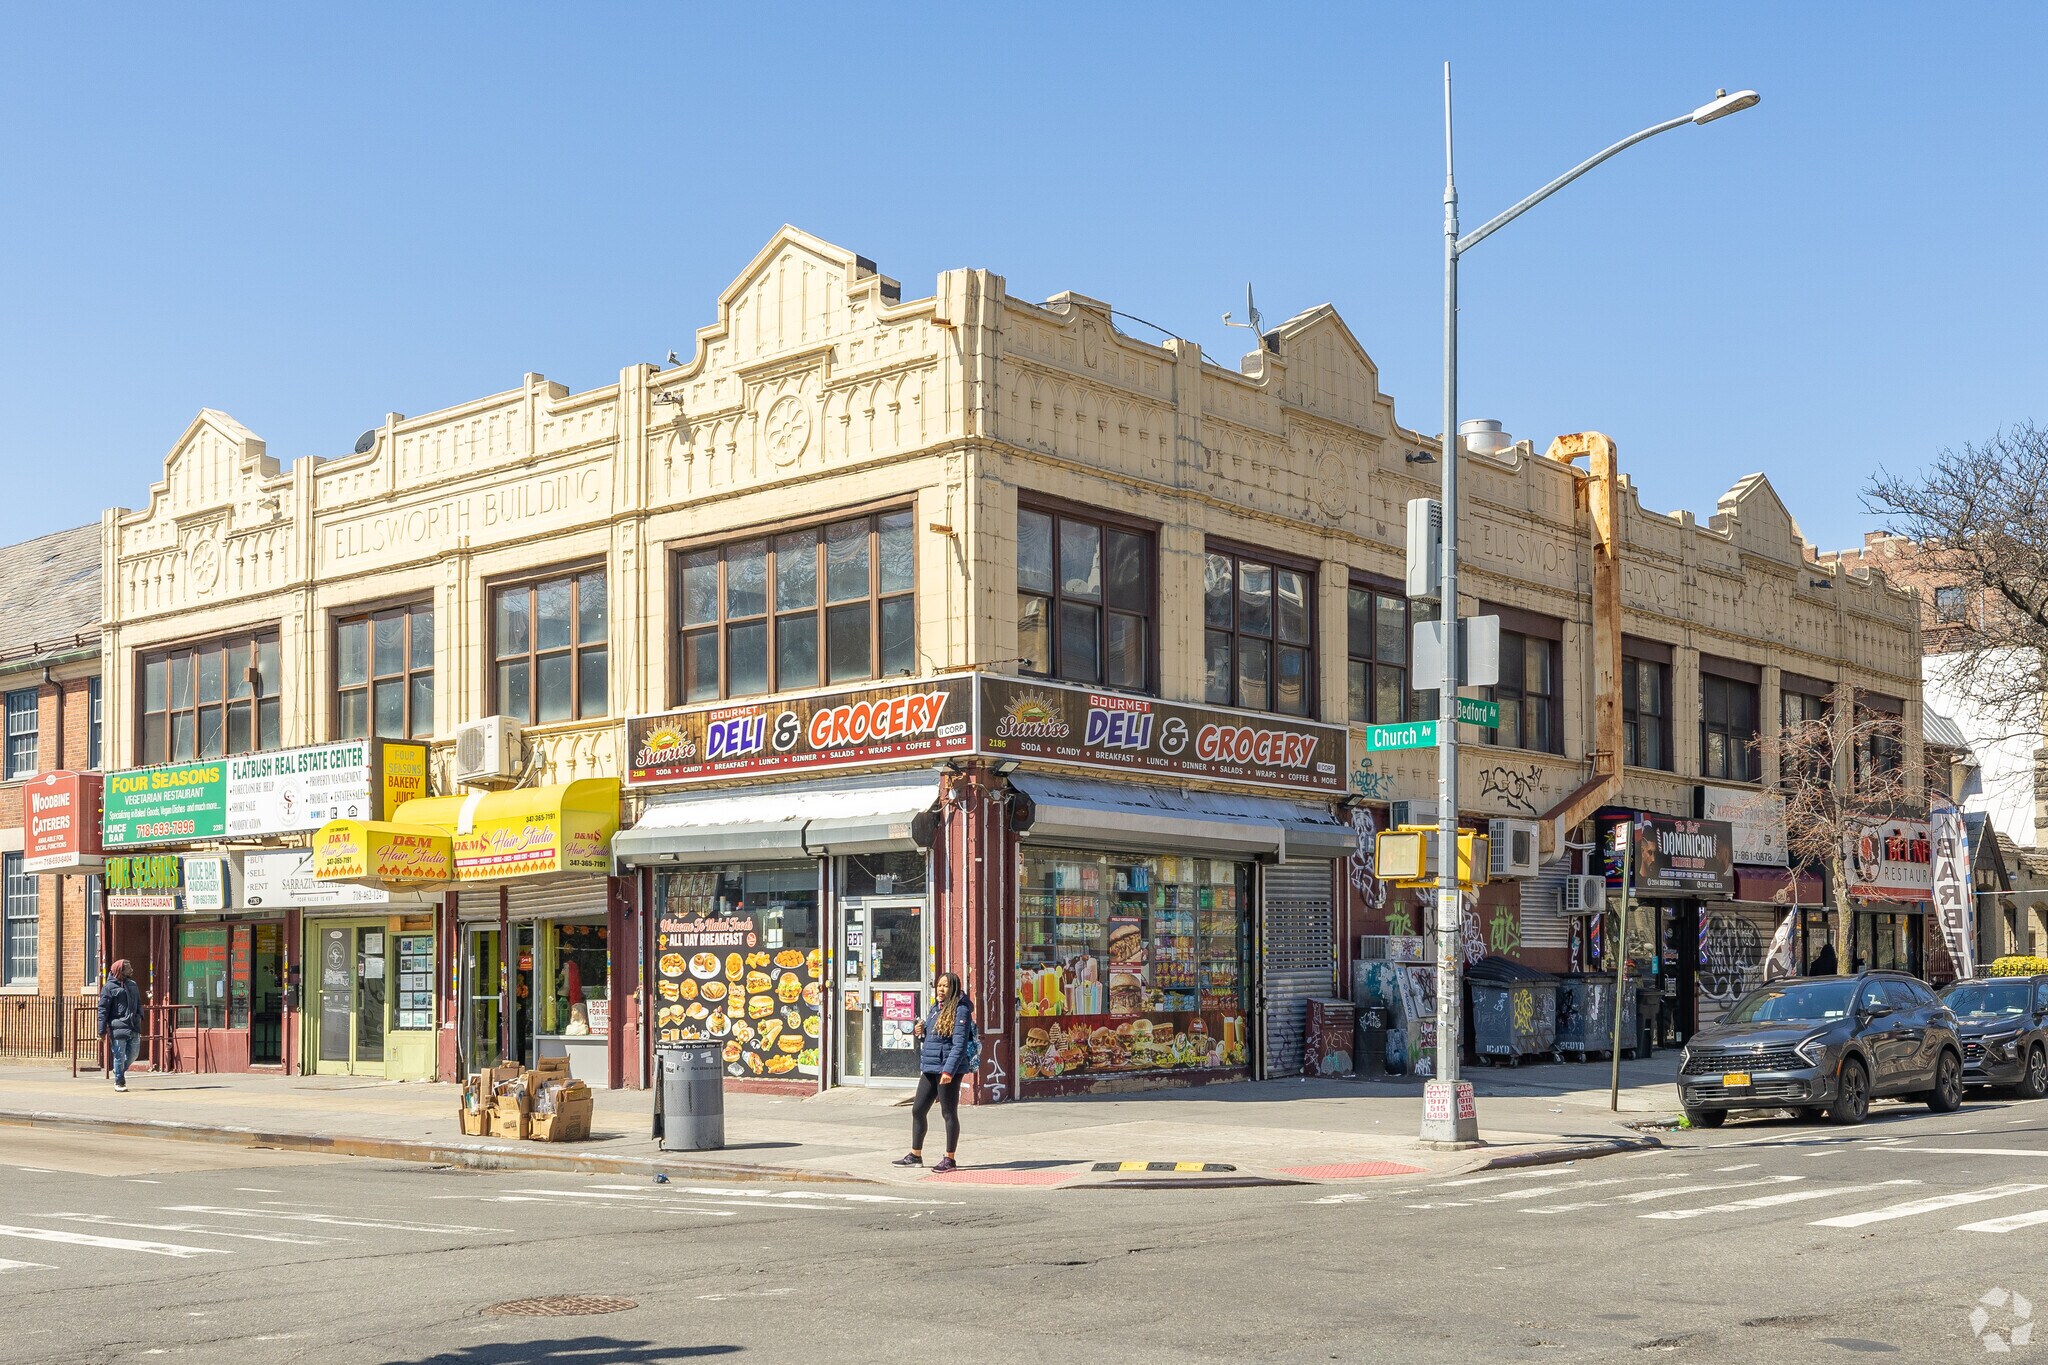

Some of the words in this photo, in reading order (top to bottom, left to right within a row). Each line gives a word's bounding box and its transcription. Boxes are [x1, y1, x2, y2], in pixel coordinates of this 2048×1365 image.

[335, 498, 470, 559] ELLSWORTH
[484, 468, 599, 527] BUILDING
[1090, 695, 1149, 712] GOURMET
[711, 706, 758, 720] GOURMET
[1457, 700, 1487, 723] Bedford
[1489, 705, 1497, 718] Av
[705, 713, 767, 760] DELI
[772, 711, 801, 752] &
[809, 690, 950, 749] GROCERY
[945, 724, 965, 735] CORP.
[996, 715, 1070, 738] Sunrise
[1084, 708, 1154, 750] DELI
[1159, 717, 1189, 755] &
[1195, 723, 1319, 769] GROCERY
[1374, 728, 1416, 747] Church
[1421, 725, 1431, 737] Av
[394, 750, 415, 761] FOUR
[635, 741, 696, 768] Sunrise
[656, 768, 671, 776] SODA
[682, 765, 702, 773] CANDY
[714, 761, 748, 770] BREAKFAST
[758, 757, 780, 766] LUNCH
[792, 753, 817, 762] DINNER
[830, 749, 855, 759] SALADS
[868, 745, 892, 755] WRAPS
[905, 741, 931, 750] COFFEE
[946, 737, 967, 746] MORE
[989, 739, 1006, 748] 2186
[1021, 742, 1041, 752] SODA
[1056, 746, 1081, 756] CANDY
[1095, 751, 1134, 762] BREAKFAST
[1146, 757, 1169, 767] LUNCH
[1182, 761, 1207, 771] DINNER
[1219, 765, 1243, 775] SALADS
[1255, 769, 1277, 779] WRAPS
[1288, 773, 1309, 782] COFFEE
[1312, 775, 1318, 783] &
[1321, 776, 1337, 785] MORE
[232, 758, 272, 780] FLATBUSH
[275, 755, 295, 775] REAL
[298, 750, 328, 773] ESTATE
[330, 747, 363, 769] CENTER
[388, 764, 421, 775] SEASONS
[111, 776, 149, 794] FOUR
[151, 767, 220, 789] SEASONS
[309, 774, 331, 787] PROPERTY
[332, 771, 362, 785] MANAGEMENT
[388, 775, 420, 790] BAKERY
[124, 792, 162, 806] VEGETARIAN
[163, 786, 205, 801] RESTAURANT
[232, 783, 261, 796] FORECLOSURE
[263, 781, 274, 791] HELP
[393, 791, 415, 803] JUICE
[232, 802, 245, 812] SHORT
[245, 801, 256, 811] SALE
[232, 819, 261, 831] MODIFICATION
[525, 813, 556, 823] 347-365-7191
[106, 823, 127, 834] JUICE
[136, 819, 195, 838] 718-693-7996
[574, 831, 594, 841] D&M
[108, 833, 124, 843] BAR
[328, 833, 350, 844] D&M
[392, 835, 432, 848] D&M
[453, 839, 479, 851] D&M
[491, 828, 518, 853] Hair
[517, 824, 554, 851] Studio
[1662, 831, 1714, 859] DOMINICAN
[376, 844, 408, 863] Hair
[406, 847, 447, 865] Studio
[564, 843, 585, 857] Hair
[584, 843, 609, 858] Studio
[249, 855, 265, 863] BUY
[569, 859, 606, 868] 347-365-7191
[105, 856, 131, 890] FOUR
[131, 855, 179, 890] SEASONS
[187, 862, 203, 880] JUICE
[204, 861, 217, 880] BAR
[249, 868, 266, 877] SELL
[249, 882, 268, 891] RENT
[109, 898, 141, 908] VEGETARIAN
[141, 897, 173, 908] RESTAURANT
[660, 918, 695, 933] Welcome
[694, 918, 705, 932] To
[705, 917, 730, 932] Halal
[729, 916, 754, 931] Foods
[669, 933, 683, 947] ALL
[684, 933, 699, 947] DAY
[700, 932, 743, 946] BREAKFAST
[848, 933, 863, 946] EBT
[591, 1000, 607, 1008] BOOT
[589, 1008, 600, 1016] FOR
